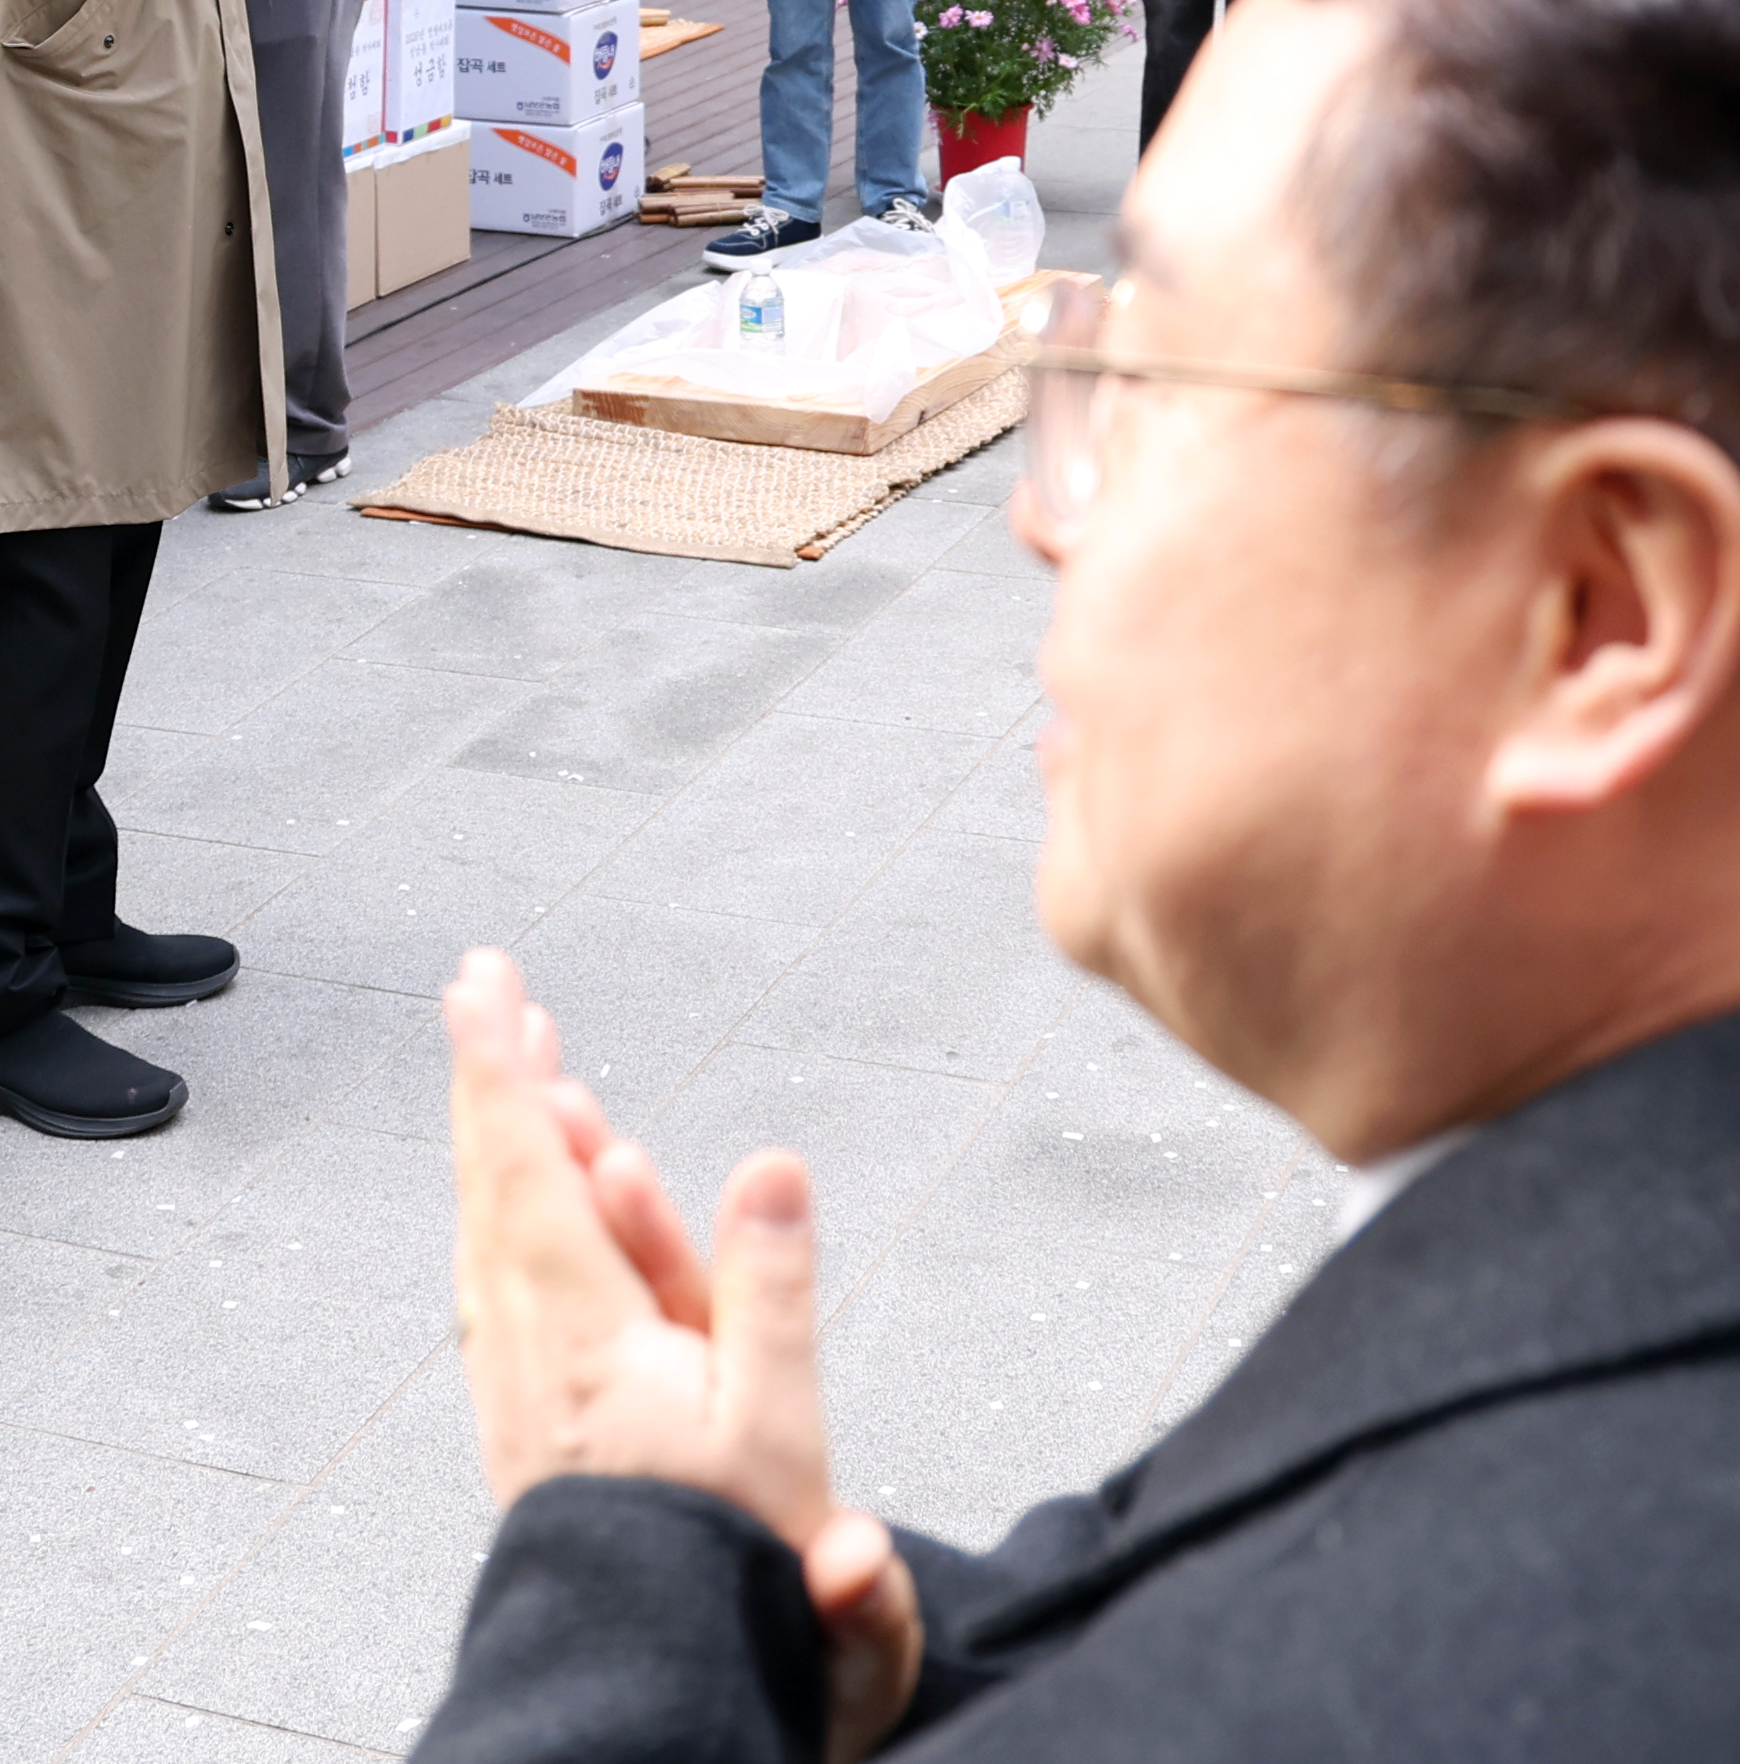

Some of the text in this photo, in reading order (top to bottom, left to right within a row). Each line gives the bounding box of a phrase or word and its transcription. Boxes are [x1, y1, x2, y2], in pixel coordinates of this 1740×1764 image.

[457, 56, 507, 74] 잡곡 세트
[493, 171, 513, 185] 세트
